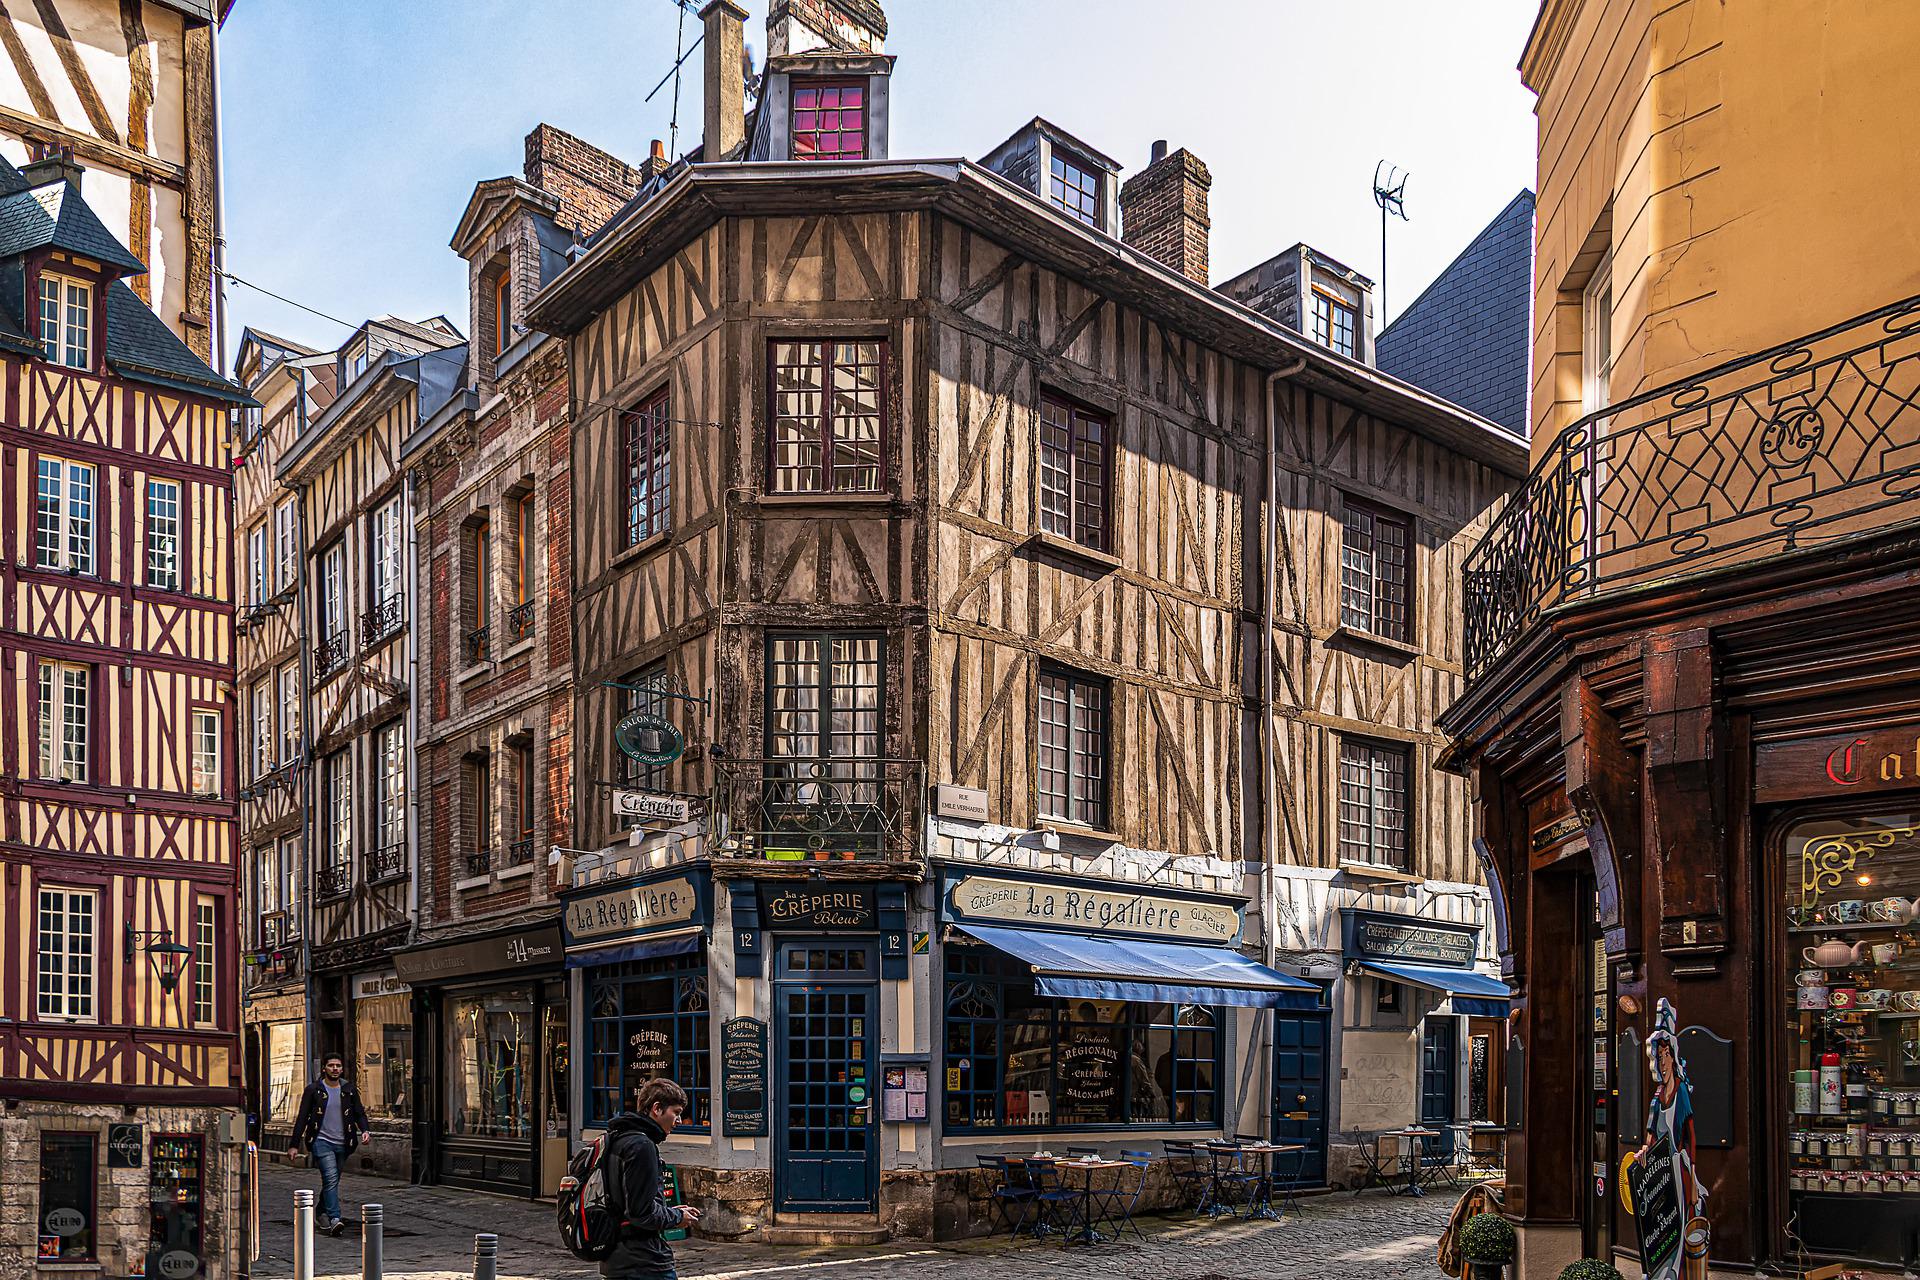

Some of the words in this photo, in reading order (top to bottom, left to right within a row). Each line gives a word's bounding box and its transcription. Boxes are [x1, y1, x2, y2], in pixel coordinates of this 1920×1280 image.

[621, 715, 649, 731] SALON
[956, 804, 986, 814] VERHAEREN
[785, 890, 797, 899] La
[575, 904, 594, 929] La
[596, 888, 678, 926] Régalière
[770, 893, 863, 917] CRÊPERIE
[971, 889, 1018, 910] CRÊPERIE
[1027, 886, 1055, 916] La
[1064, 890, 1181, 929] Régalière
[1190, 908, 1226, 935] GLACIER
[814, 910, 861, 925] Bleue
[739, 933, 752, 947] 12
[1389, 926, 1416, 940] GALETTES
[1415, 927, 1438, 942] SALADES
[887, 935, 900, 949] 12
[513, 937, 528, 963] 14
[1366, 940, 1386, 951] SALON
[1440, 948, 1467, 960] BOUTIQUE
[727, 1021, 760, 1033] CRÊPERIE
[630, 1029, 668, 1045] CRÊPERIE
[1075, 1033, 1110, 1043] Produits
[636, 1045, 661, 1058] Glacier
[1065, 1046, 1118, 1060] RÉGIONAUX
[1067, 1088, 1093, 1099] SALON
[1637, 1156, 1670, 1197] MADELEINES
